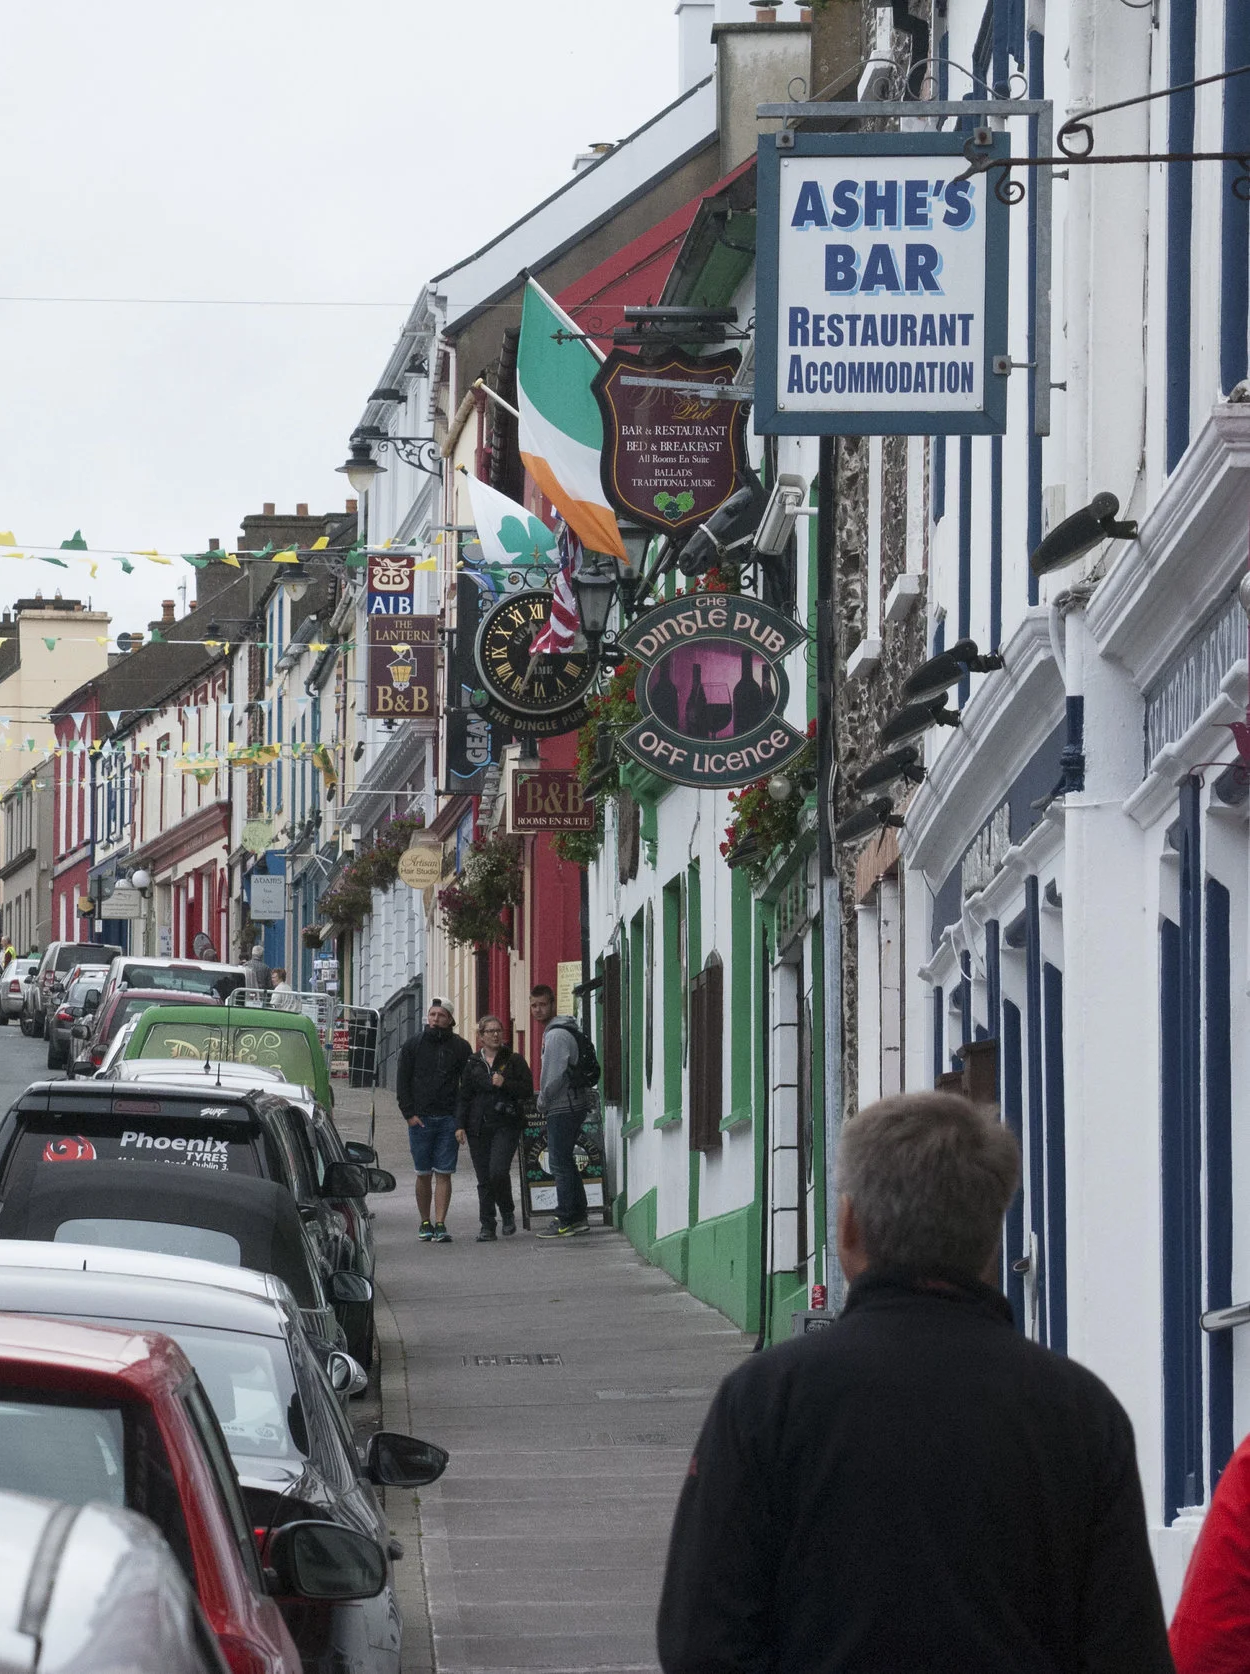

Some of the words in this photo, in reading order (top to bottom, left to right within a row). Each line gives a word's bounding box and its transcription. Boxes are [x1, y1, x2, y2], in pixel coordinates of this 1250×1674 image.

[791, 179, 976, 231] ASHE'S
[825, 243, 945, 296] BAR
[788, 306, 974, 347] RESTAURANT
[787, 354, 974, 394] ACCOMMODATION
[672, 400, 718, 420] Pub
[621, 425, 642, 436] BAR
[655, 425, 727, 436] RESTAURANT
[626, 442, 647, 452] BED
[650, 442, 657, 451] &
[660, 442, 722, 452] BREAKFAST
[638, 455, 650, 464] All
[652, 455, 677, 464] Rooms
[679, 455, 690, 464] En
[692, 455, 710, 464] Suite
[654, 468, 693, 477] BALLADS
[631, 479, 689, 487] TRADITIONAL
[690, 479, 716, 487] MUSIC
[371, 596, 411, 615] AIB
[394, 620, 412, 629] THE
[375, 630, 430, 641] LANTERN
[634, 608, 728, 657] DINGLE
[733, 611, 786, 653] PUB
[533, 665, 553, 675] IME
[376, 685, 429, 712] B&B
[489, 706, 511, 726] THE
[514, 719, 558, 732] DINGLE
[562, 708, 585, 726] PUB
[638, 731, 688, 766] OFF
[524, 781, 585, 814] B&B
[517, 817, 547, 826] ROOMS
[549, 817, 562, 826] EN
[563, 817, 590, 826] SUITE
[402, 855, 438, 867] Artisan
[401, 867, 414, 875] Hair
[200, 1107, 229, 1118] SURF
[120, 1131, 230, 1153] Phoenix
[185, 1151, 228, 1163] TYRES
